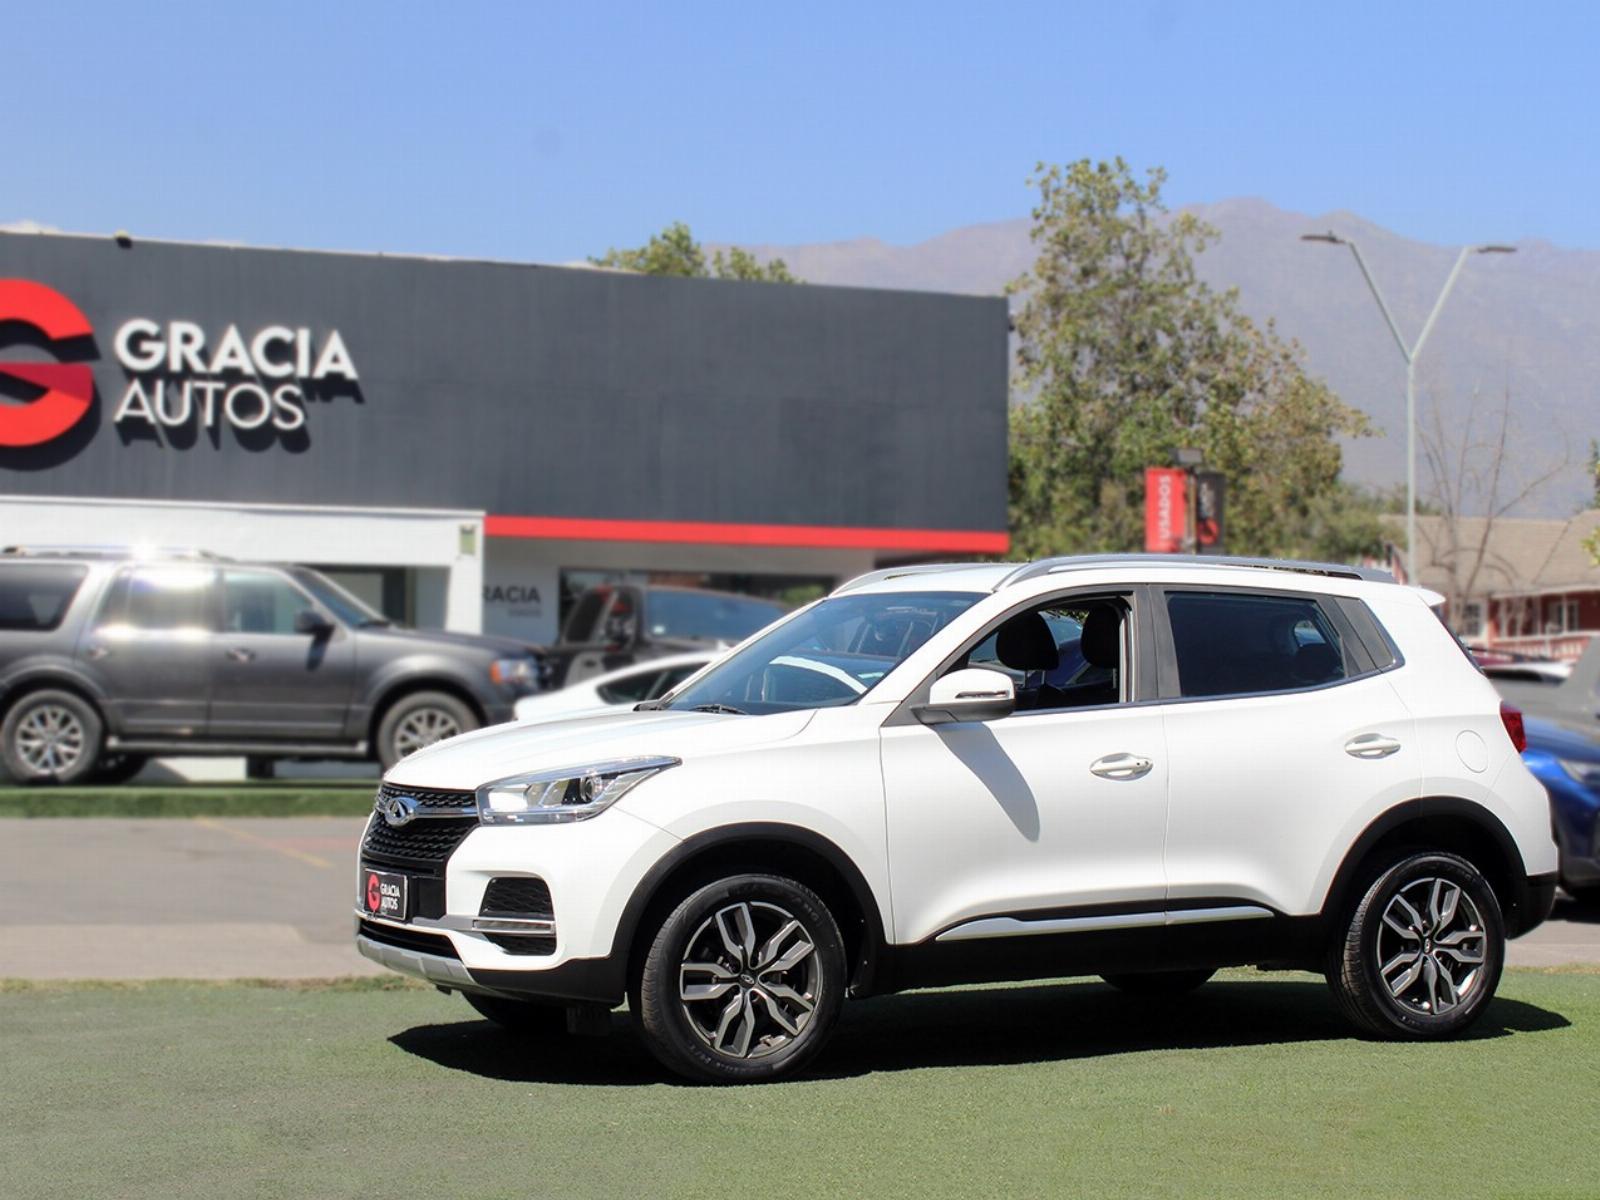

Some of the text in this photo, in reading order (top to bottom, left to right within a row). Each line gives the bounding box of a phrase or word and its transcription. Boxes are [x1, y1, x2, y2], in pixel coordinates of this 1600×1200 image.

[114, 318, 359, 380] GRACIA
[113, 378, 306, 432] AUTOS
[1157, 474, 1171, 539] USADOS
[380, 883, 401, 898] GRACIA
[381, 896, 399, 910] AUTOS
